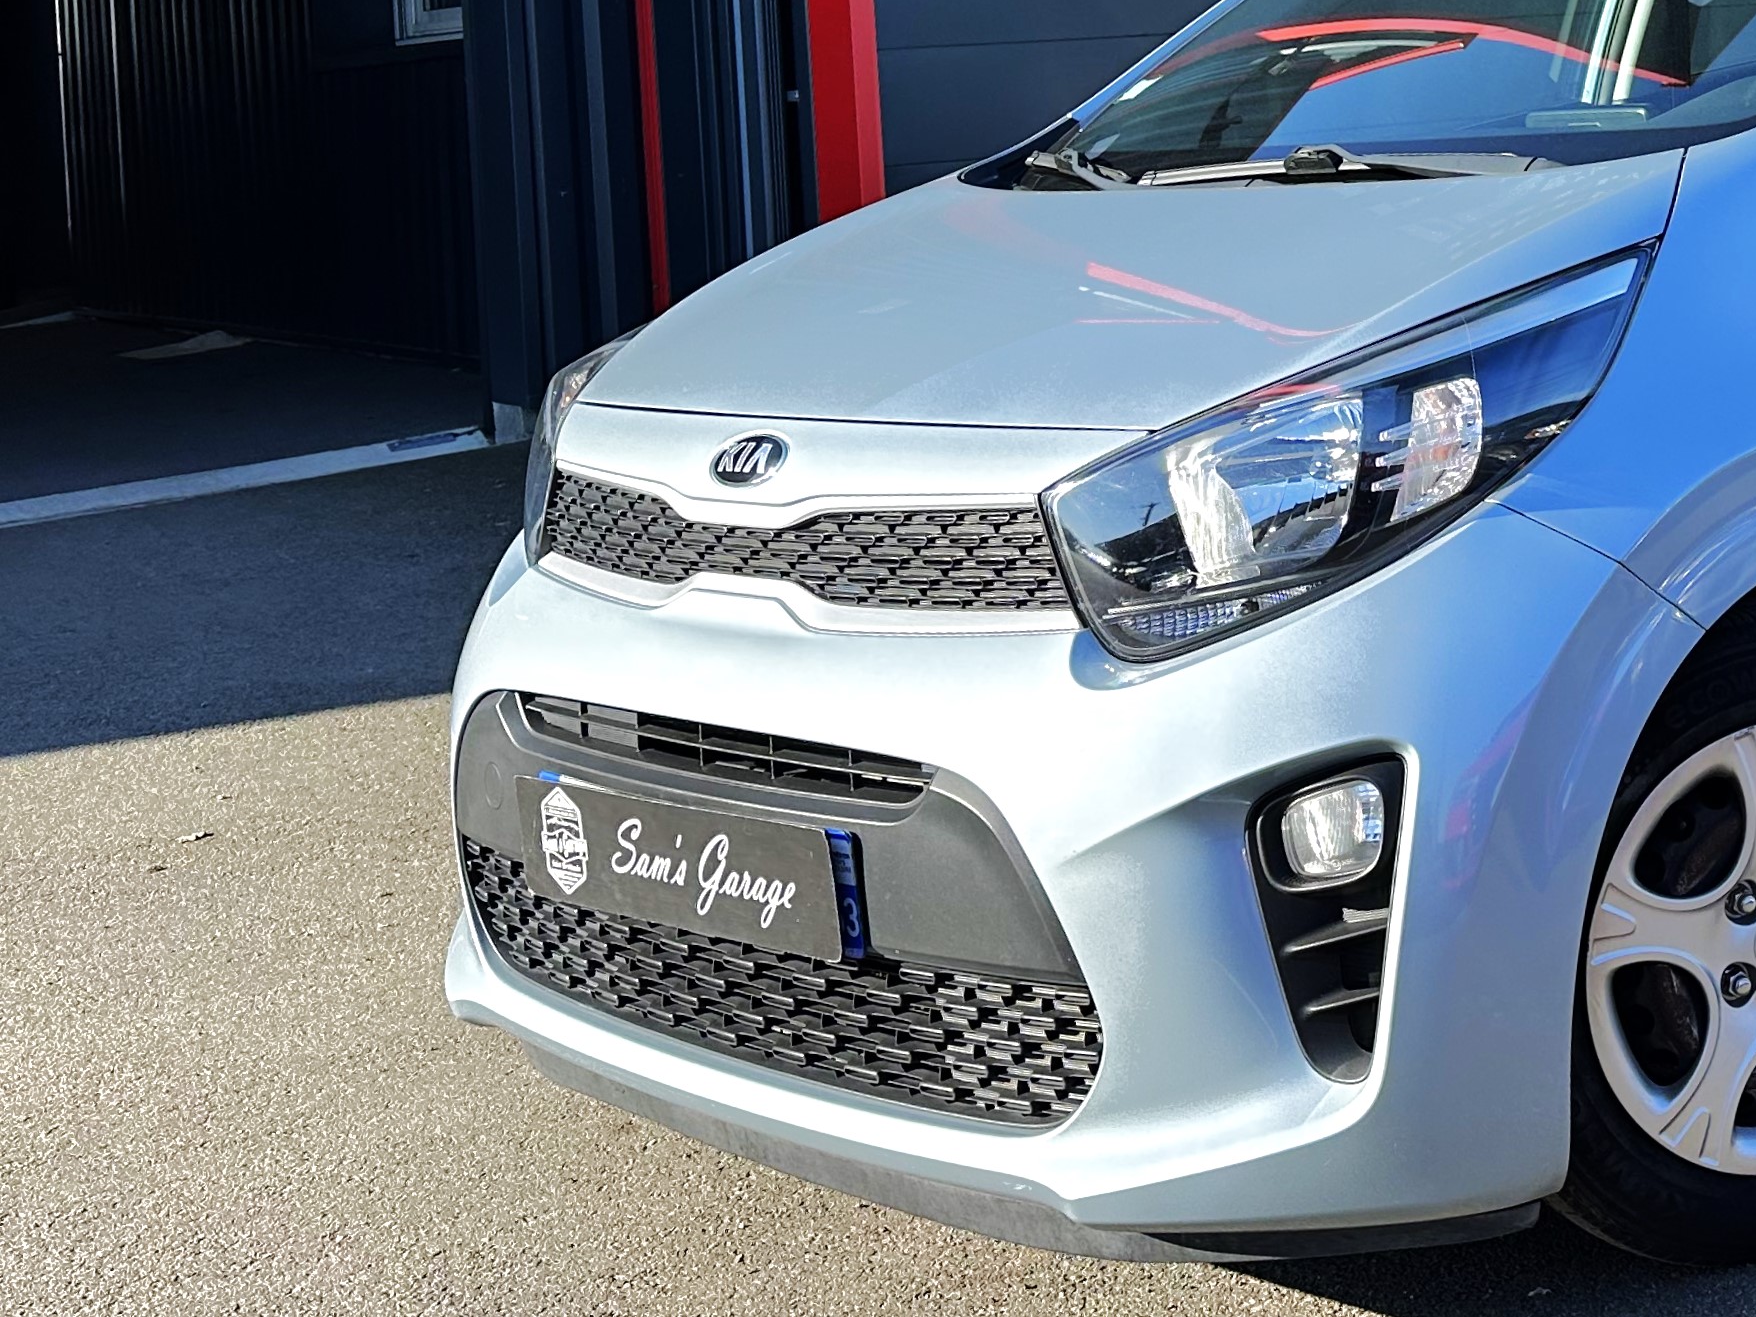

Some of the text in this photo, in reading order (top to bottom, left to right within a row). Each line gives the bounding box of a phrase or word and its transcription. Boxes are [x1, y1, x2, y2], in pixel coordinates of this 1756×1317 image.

[716, 441, 774, 474] KIA
[611, 817, 796, 929] Sam's Garage
[841, 897, 860, 938] 3
